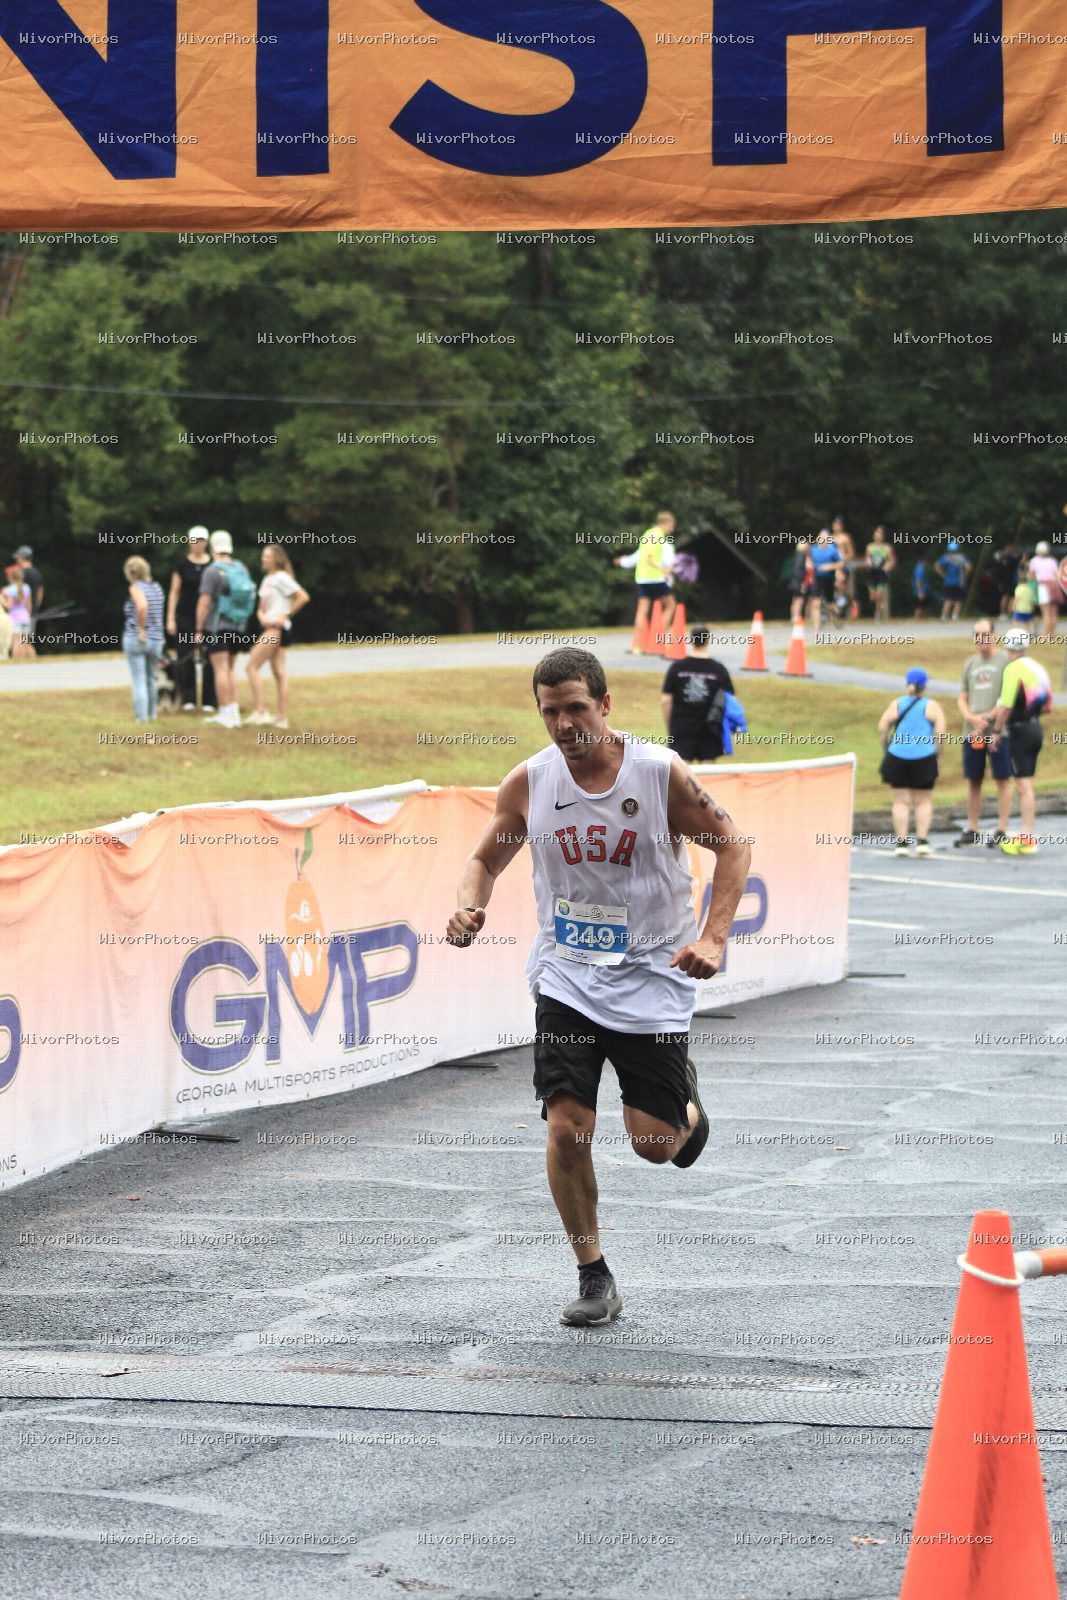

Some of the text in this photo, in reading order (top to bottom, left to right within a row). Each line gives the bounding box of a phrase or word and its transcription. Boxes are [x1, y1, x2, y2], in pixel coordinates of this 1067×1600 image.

[555, 825, 637, 867] USA
[566, 923, 614, 949] 249
[169, 920, 419, 1075] GMP
[245, 1068, 336, 1093] MULTISPORTS
[340, 1045, 421, 1078] PRODUCTIONS
